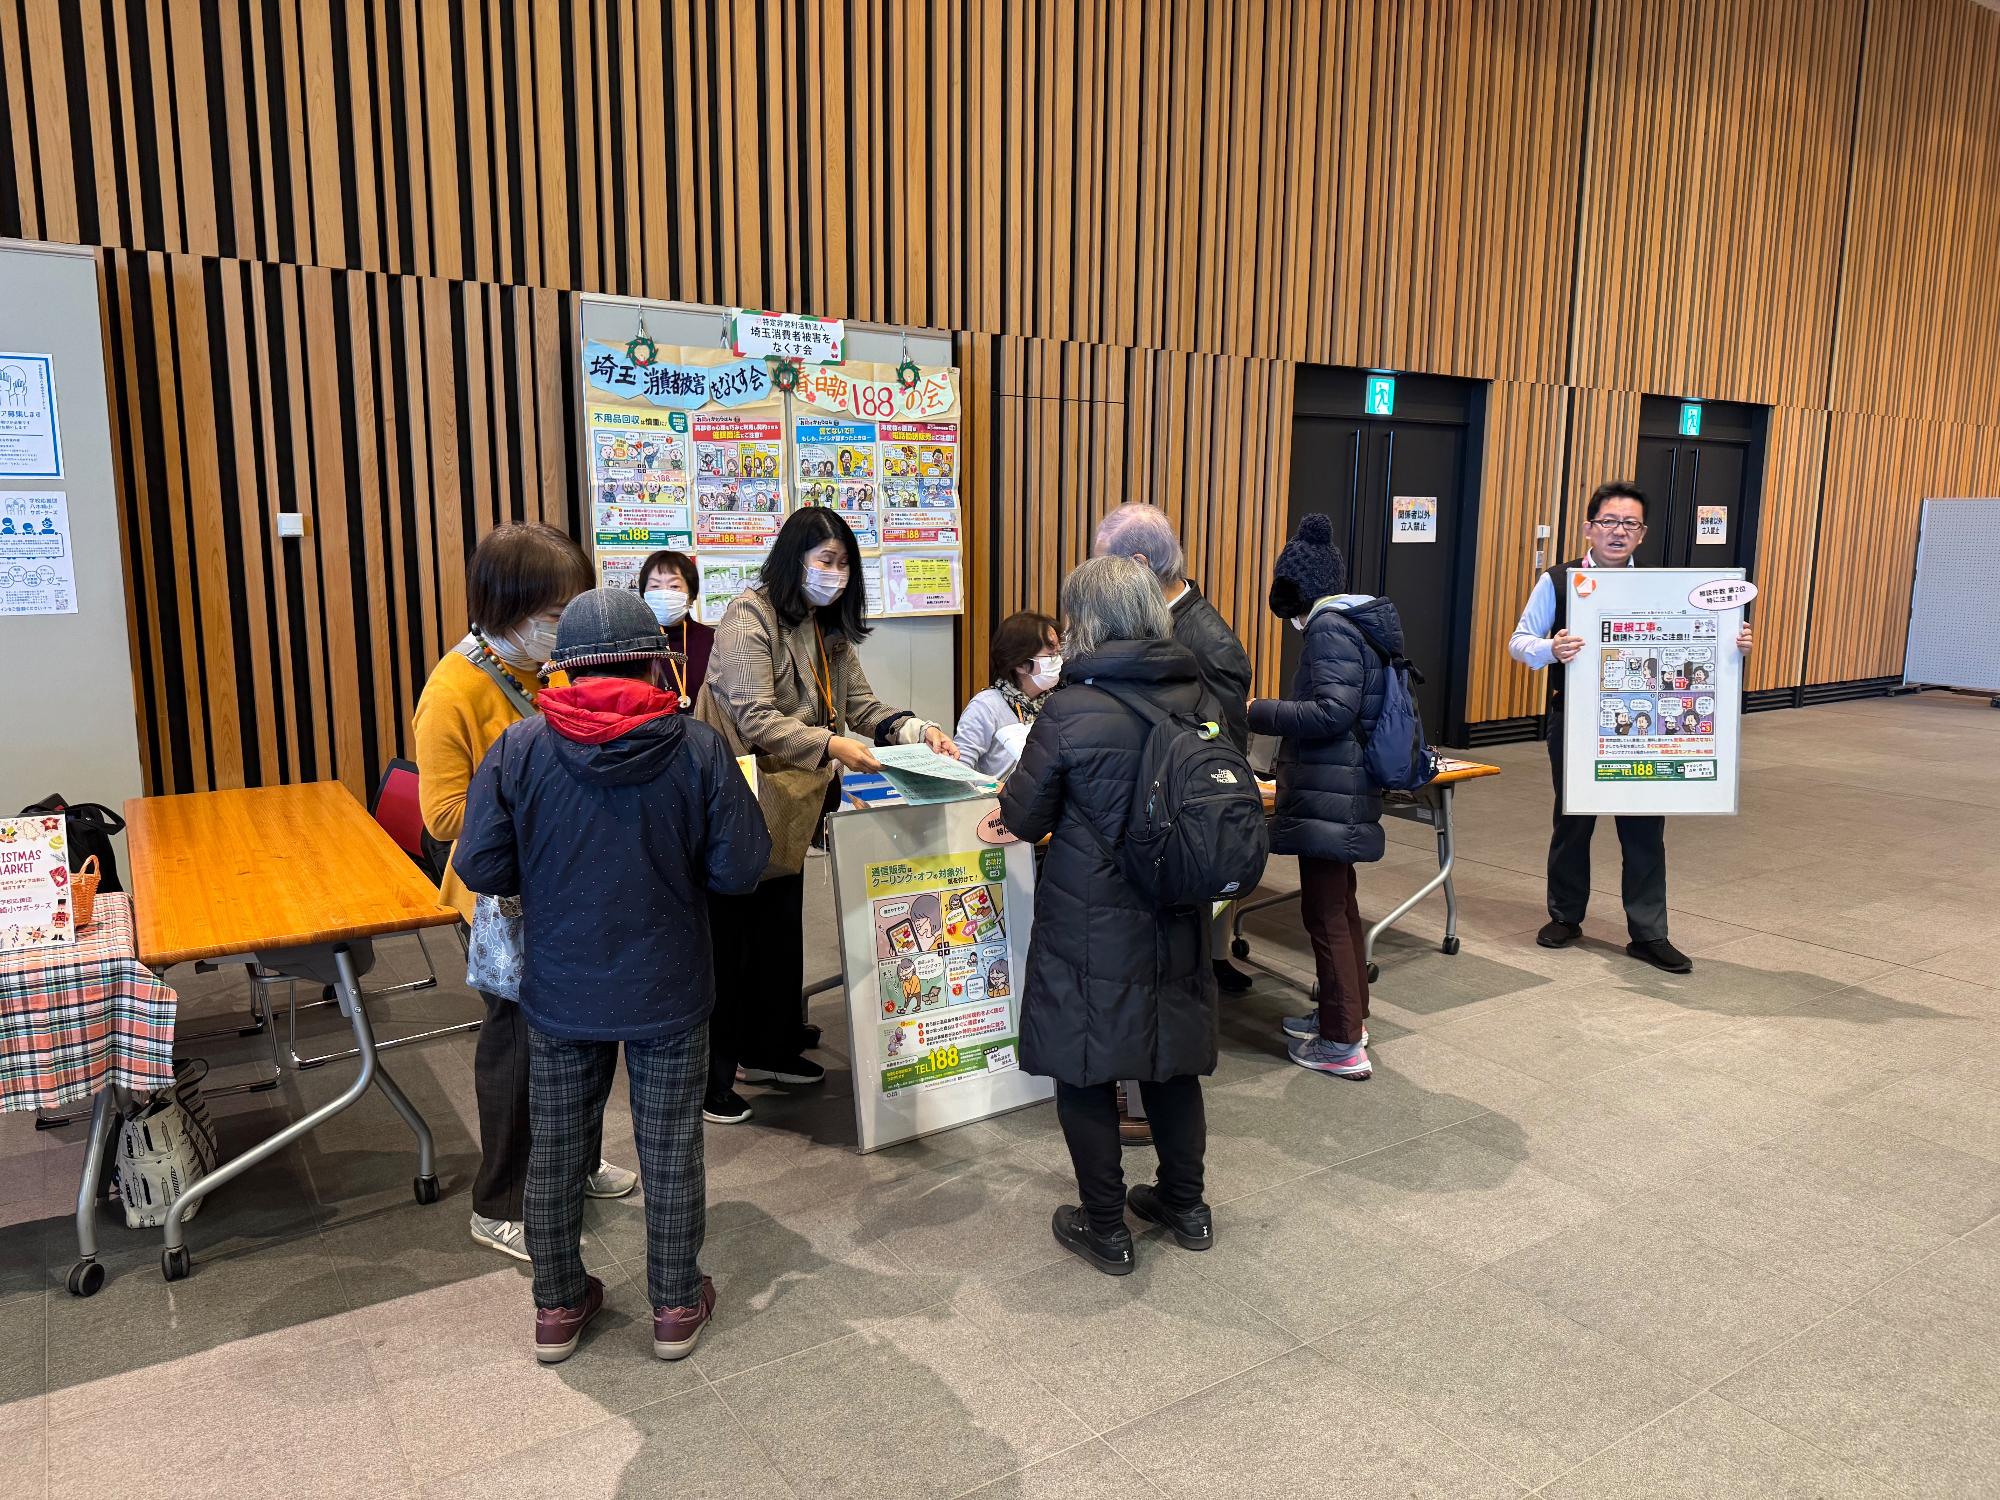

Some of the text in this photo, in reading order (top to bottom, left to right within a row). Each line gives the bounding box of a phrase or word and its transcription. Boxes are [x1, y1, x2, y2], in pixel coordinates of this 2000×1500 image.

[762, 318, 825, 332] 特定非営利活動法人
[751, 326, 831, 344] 埼玉消費者被害を
[773, 342, 813, 355] なくす会
[1398, 510, 1431, 519] 関係者以外
[1400, 522, 1427, 531] 立入禁止
[871, 864, 912, 877] 通信販売は
[915, 1047, 959, 1074] TEL188
